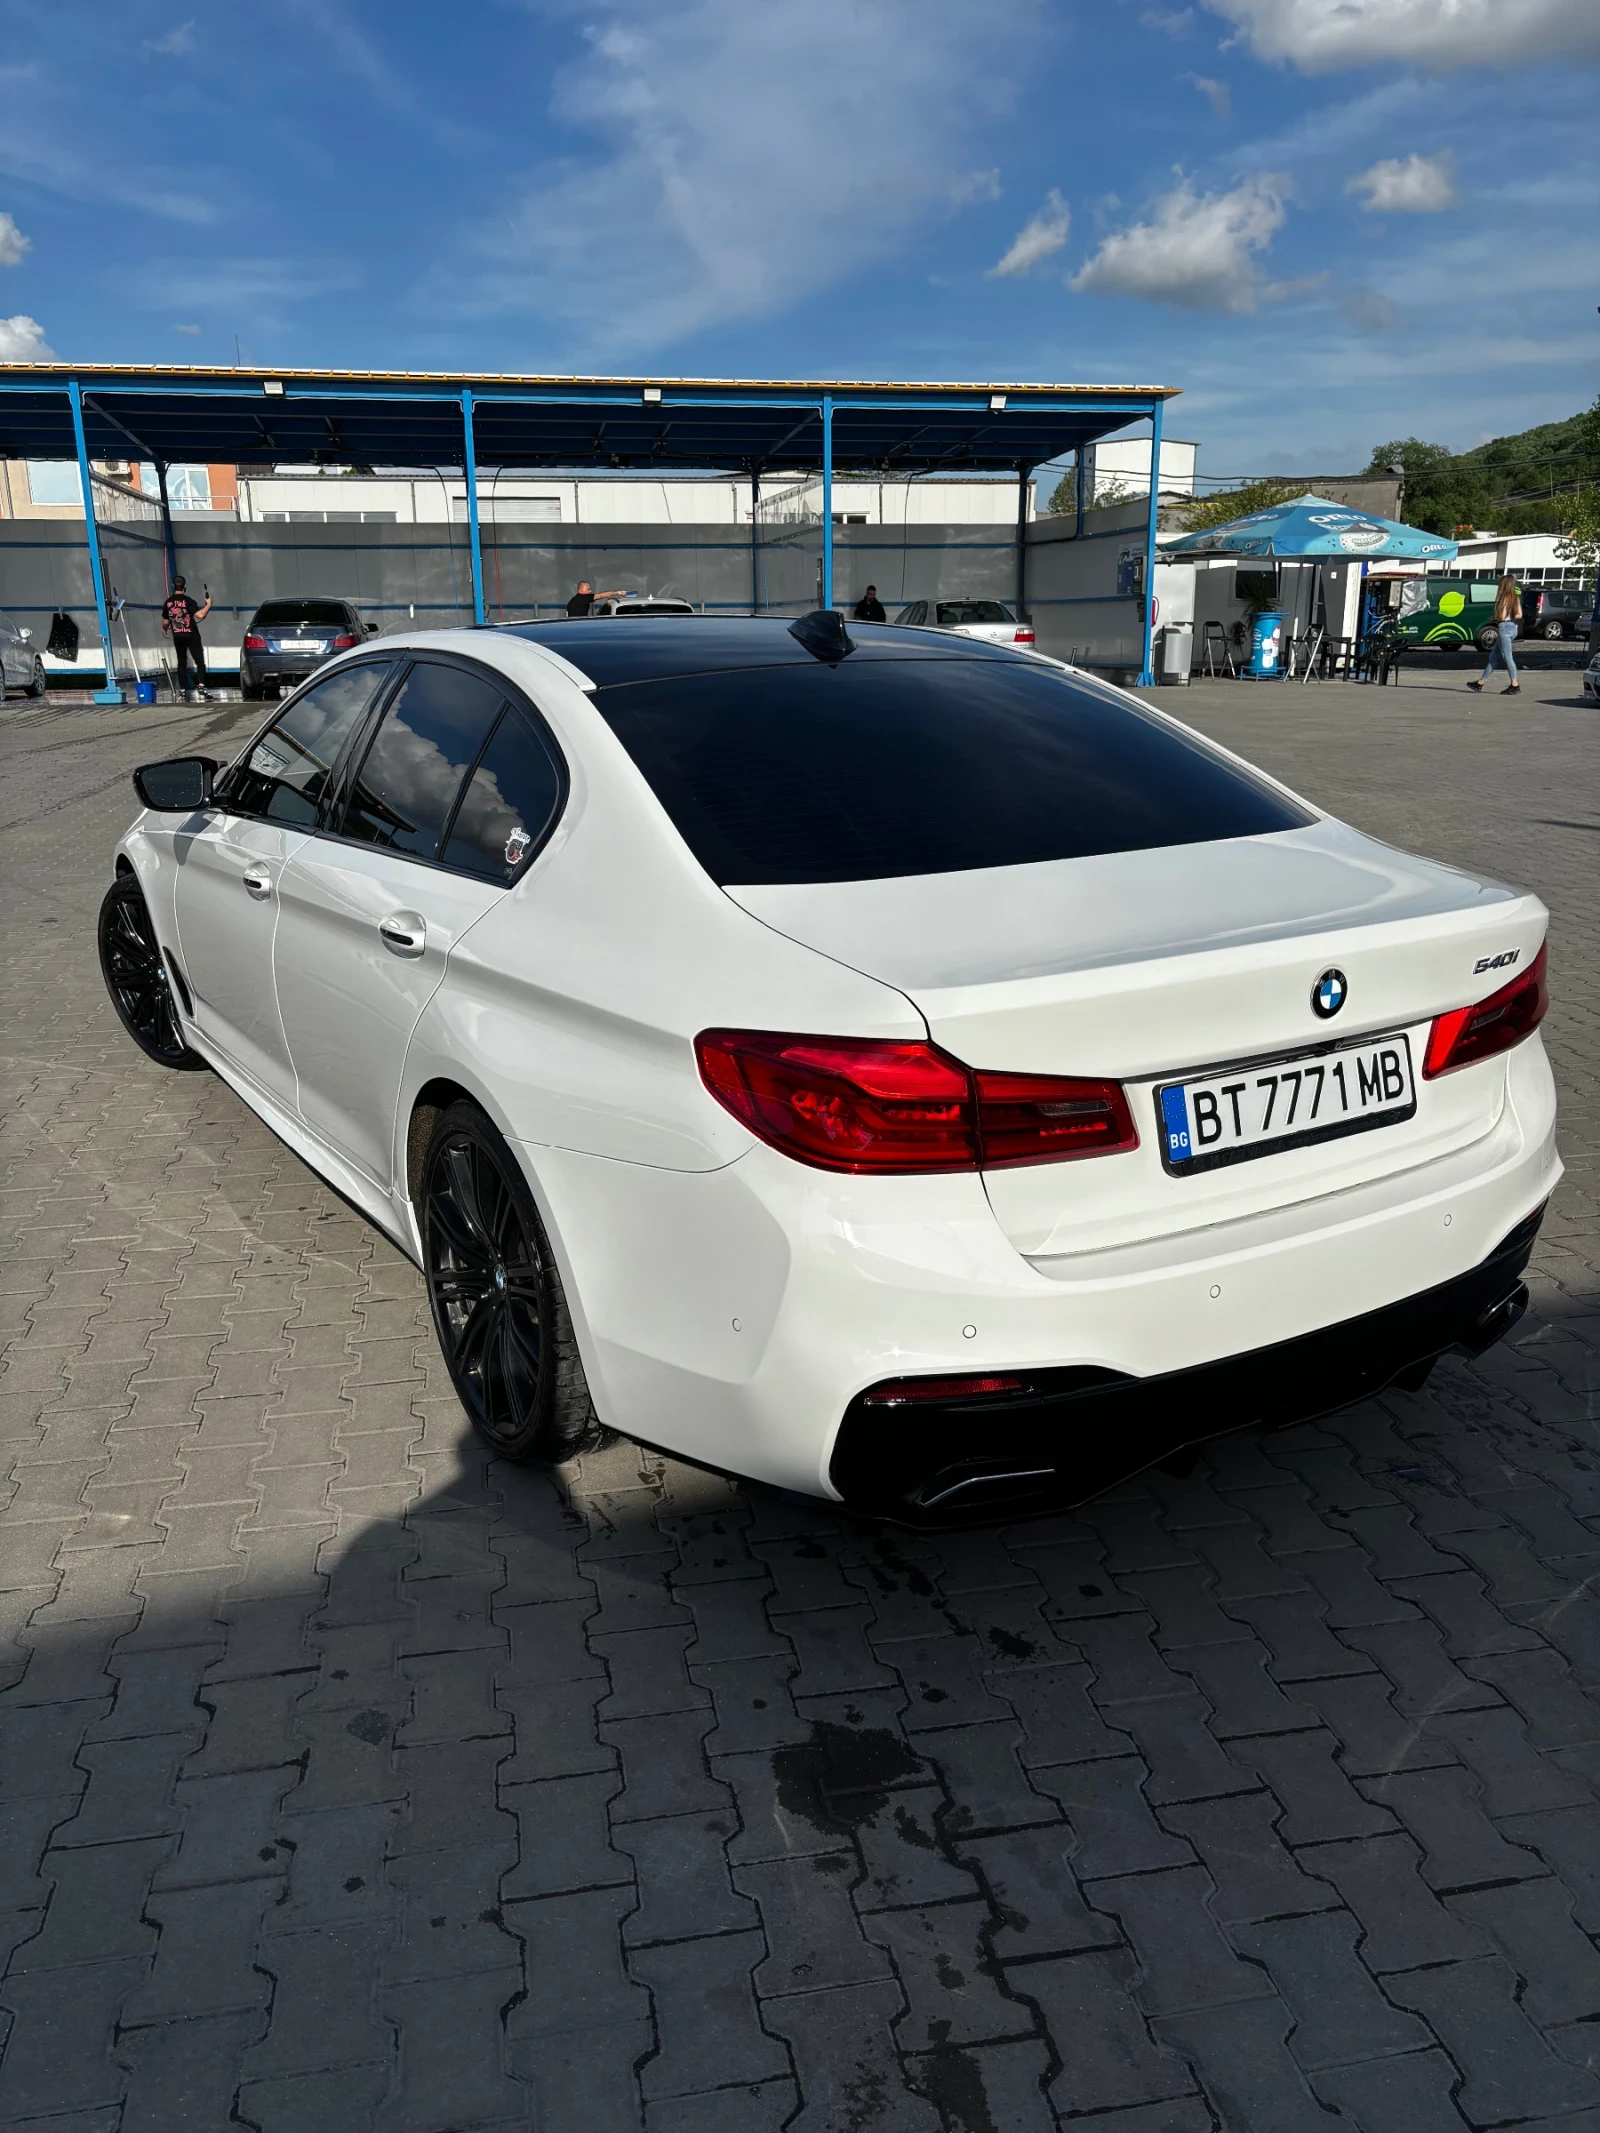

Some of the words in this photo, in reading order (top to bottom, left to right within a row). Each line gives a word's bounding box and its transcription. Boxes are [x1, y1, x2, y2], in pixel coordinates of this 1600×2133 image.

[1307, 513, 1367, 525] OREO
[1421, 544, 1447, 553] OREO
[1473, 948, 1521, 975] 540i
[1256, 1061, 1348, 1132] 7771
[1357, 1050, 1404, 1106] MB
[1170, 1131, 1188, 1149] BG
